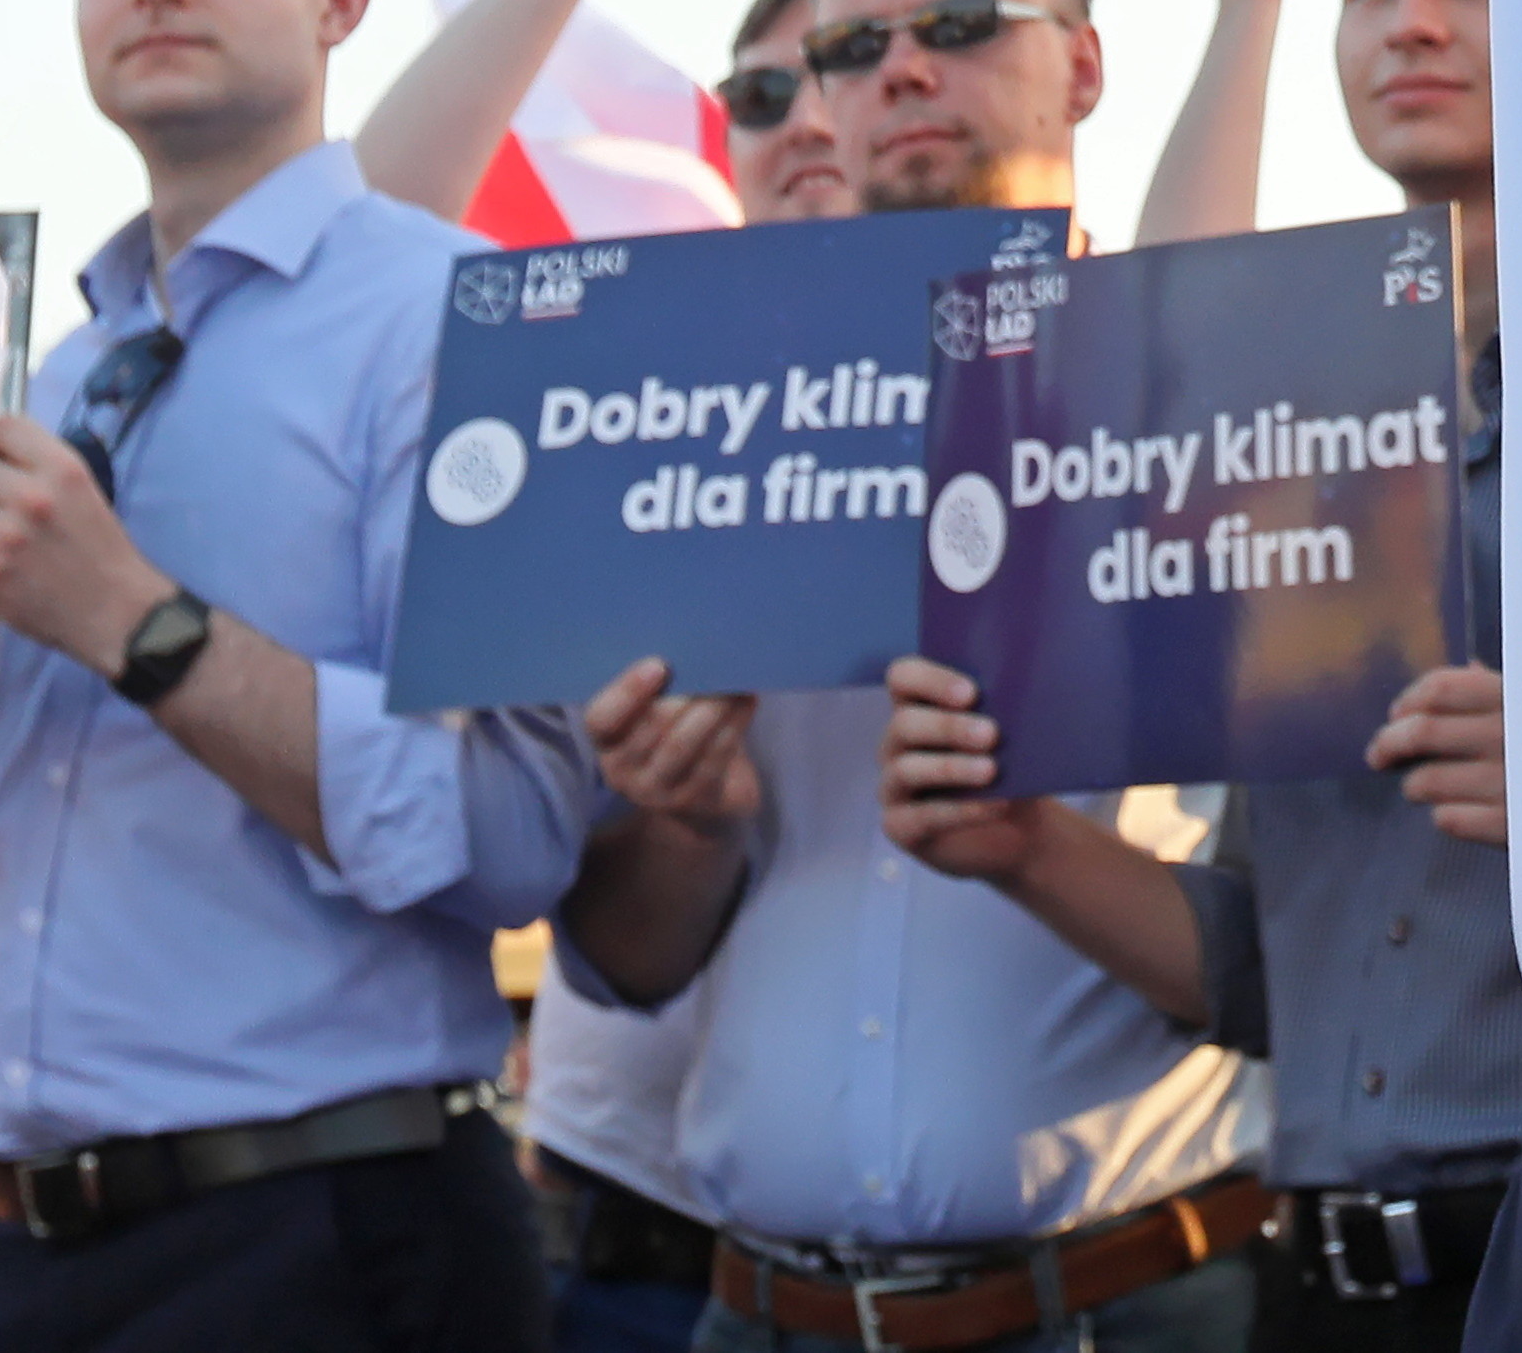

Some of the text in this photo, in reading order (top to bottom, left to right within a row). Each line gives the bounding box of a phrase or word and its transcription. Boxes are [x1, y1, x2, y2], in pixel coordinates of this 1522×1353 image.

[526, 245, 631, 282] POLSKI
[985, 273, 1070, 316] POLSKI
[536, 375, 773, 456] Dobry
[1010, 394, 1448, 515] Dobry klimat
[621, 450, 930, 534] dla firm
[1086, 511, 1354, 604] dla firm
